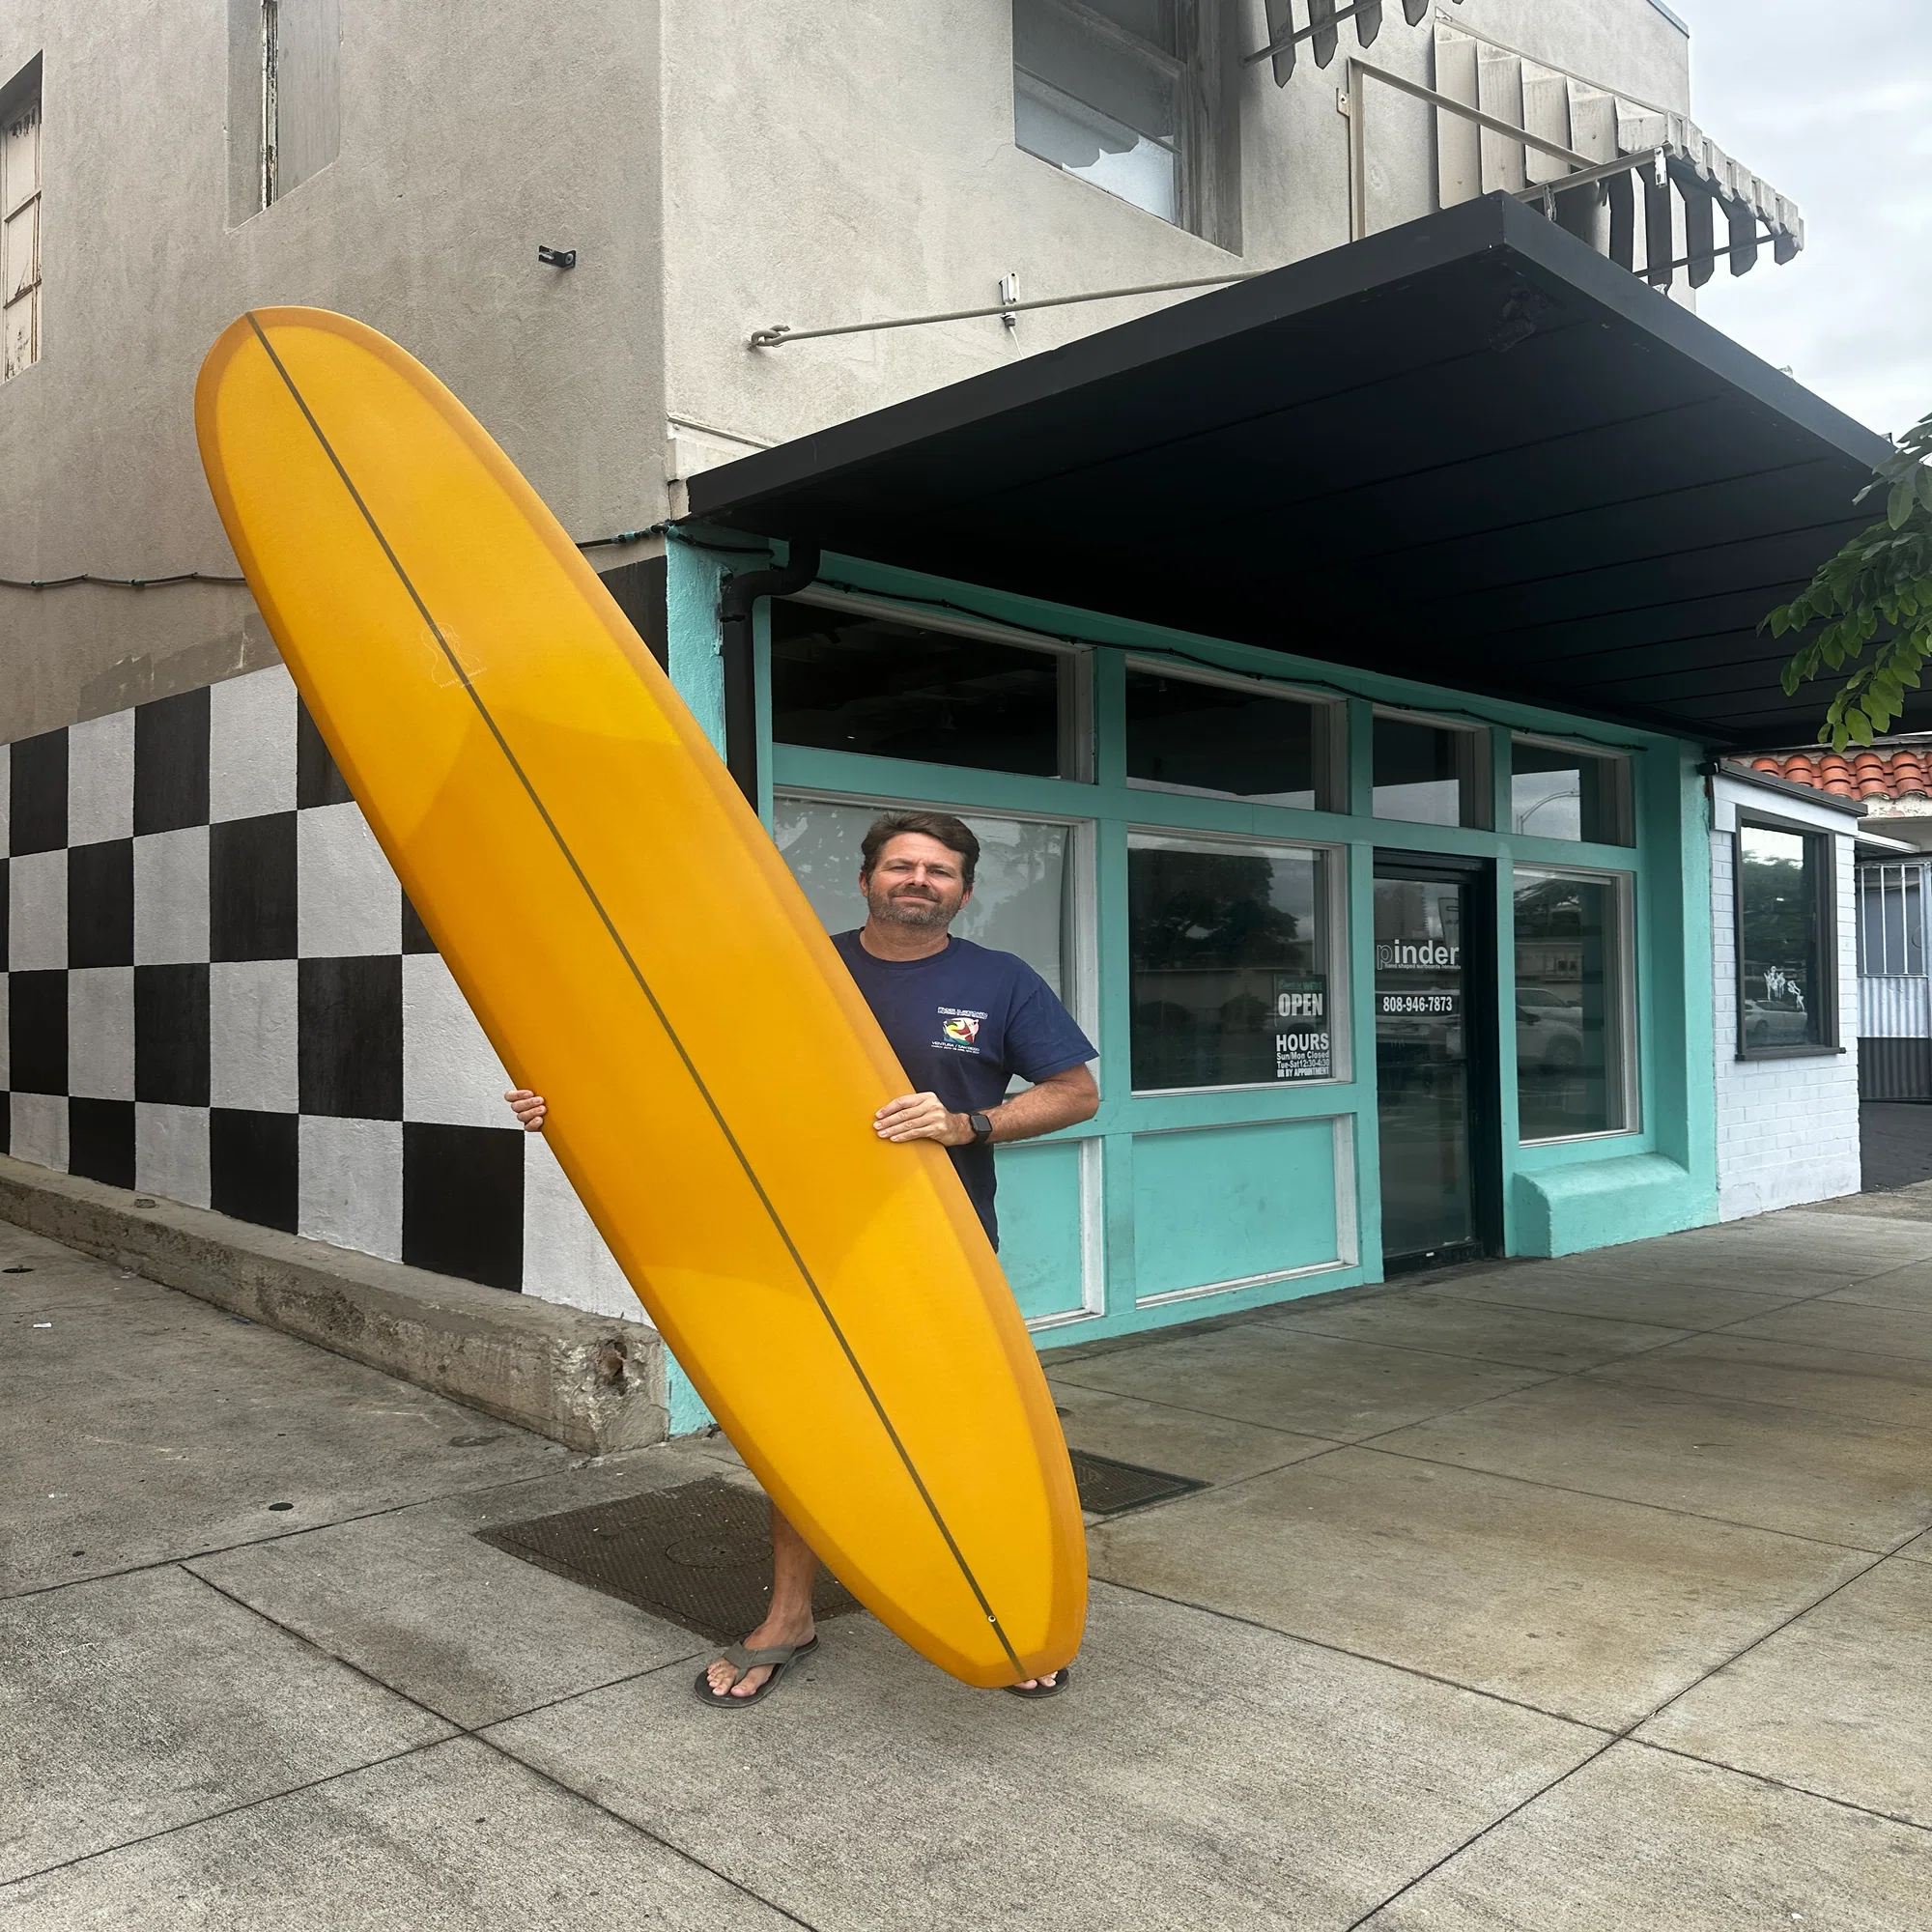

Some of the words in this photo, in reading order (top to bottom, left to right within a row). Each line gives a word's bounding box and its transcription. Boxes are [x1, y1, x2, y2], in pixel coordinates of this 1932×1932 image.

[1377, 939, 1460, 970] pinder
[1278, 993, 1323, 1017] OPEN
[1383, 996, 1453, 1012] 808-946-7873
[1276, 1033, 1329, 1051] HOURS
[1277, 1051, 1305, 1061] Sun/Mon
[1306, 1050, 1330, 1060] Closed
[1276, 1061, 1299, 1069] Tue-Sat
[1285, 1068, 1293, 1077] BY
[1293, 1066, 1329, 1077] APPOINTMENT
